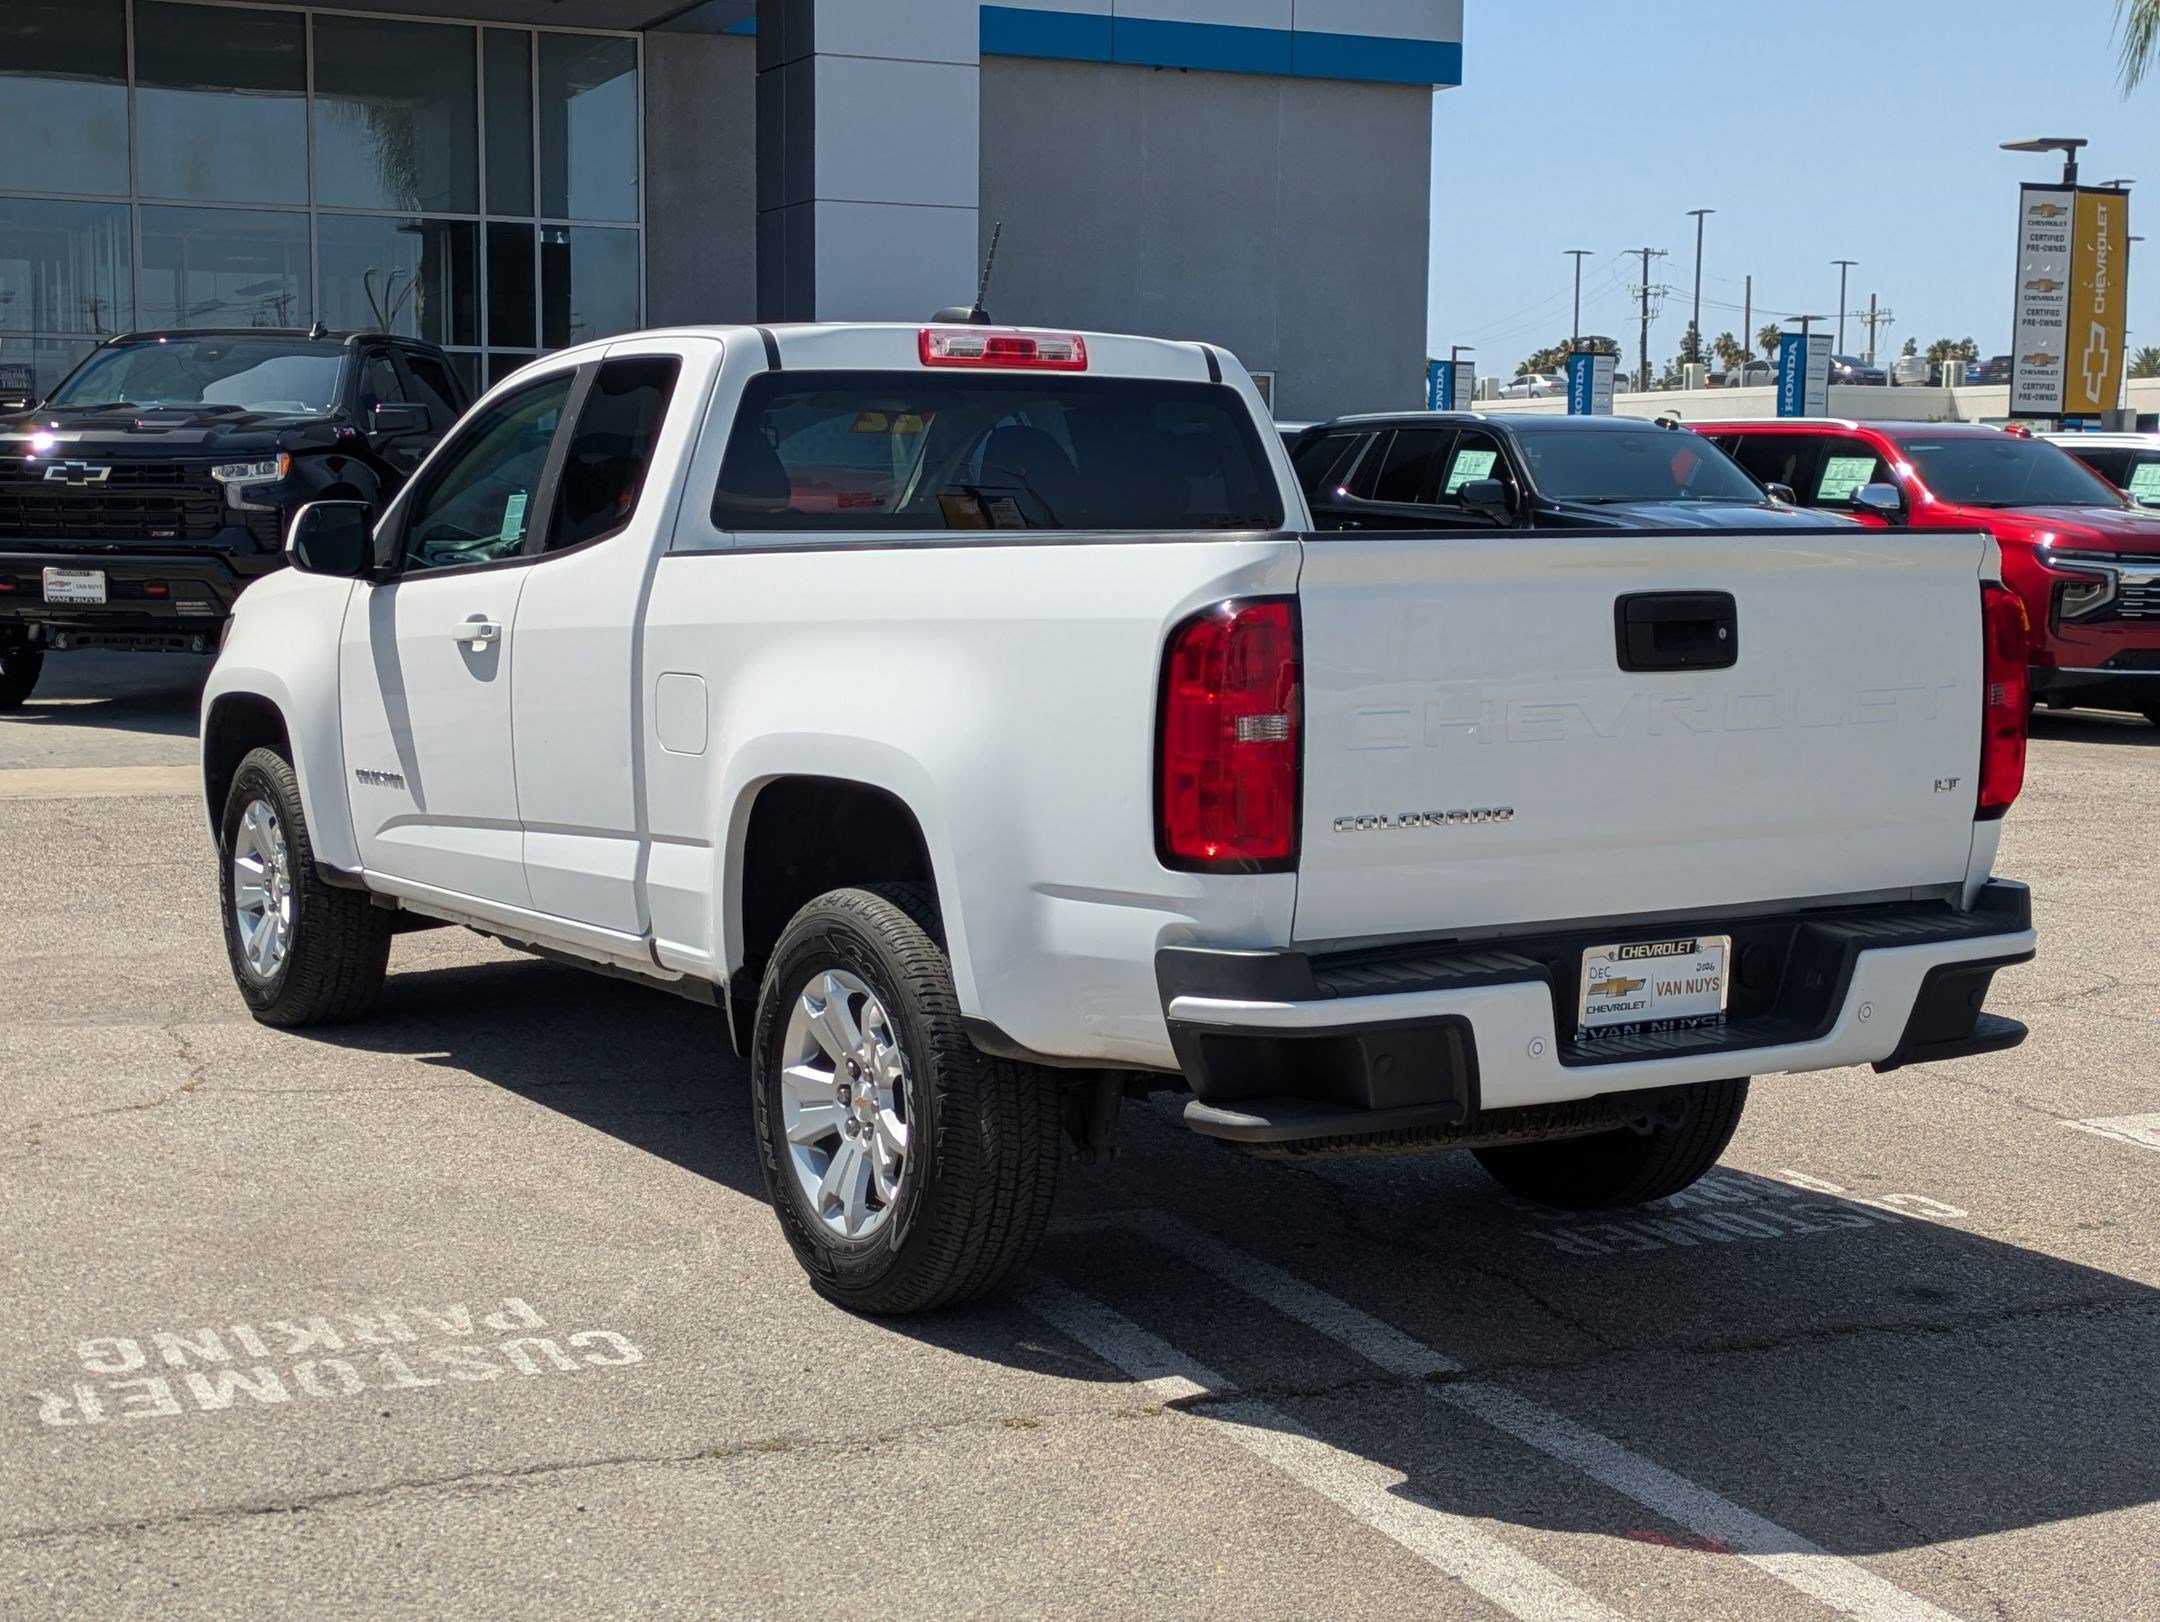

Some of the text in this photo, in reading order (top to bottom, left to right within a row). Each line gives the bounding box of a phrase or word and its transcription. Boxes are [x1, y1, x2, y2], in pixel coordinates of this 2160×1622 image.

[2027, 219, 2068, 228] CHEVROLET
[2029, 233, 2065, 243] CERTIFIED
[2026, 243, 2067, 253] PRE-OWNED
[2094, 202, 2108, 314] CHEVROLET
[2023, 294, 2063, 302] CHEVROLET
[2025, 308, 2061, 318] CERTIFIED
[2022, 318, 2063, 328] PRE-OWNED
[1784, 340, 1799, 412] HONDA
[2019, 368, 2059, 376] CHEVROLET
[1435, 366, 1445, 411] ONDA
[2022, 382, 2056, 392] CERTIFIED
[2018, 393, 2058, 402] PRE-OWNED
[1345, 679, 1957, 751] CHEVROLET
[1933, 776, 1961, 793] LT
[1333, 806, 1515, 832] COLORADO
[1621, 940, 1694, 960] CHEVROLET
[1589, 966, 1612, 980] DEC
[1656, 976, 1721, 997] VAN NUYS
[1586, 1000, 1647, 1015] CHEVROLET
[76, 1297, 550, 1375] PARKING
[32, 1330, 645, 1427] CUSTOMER
